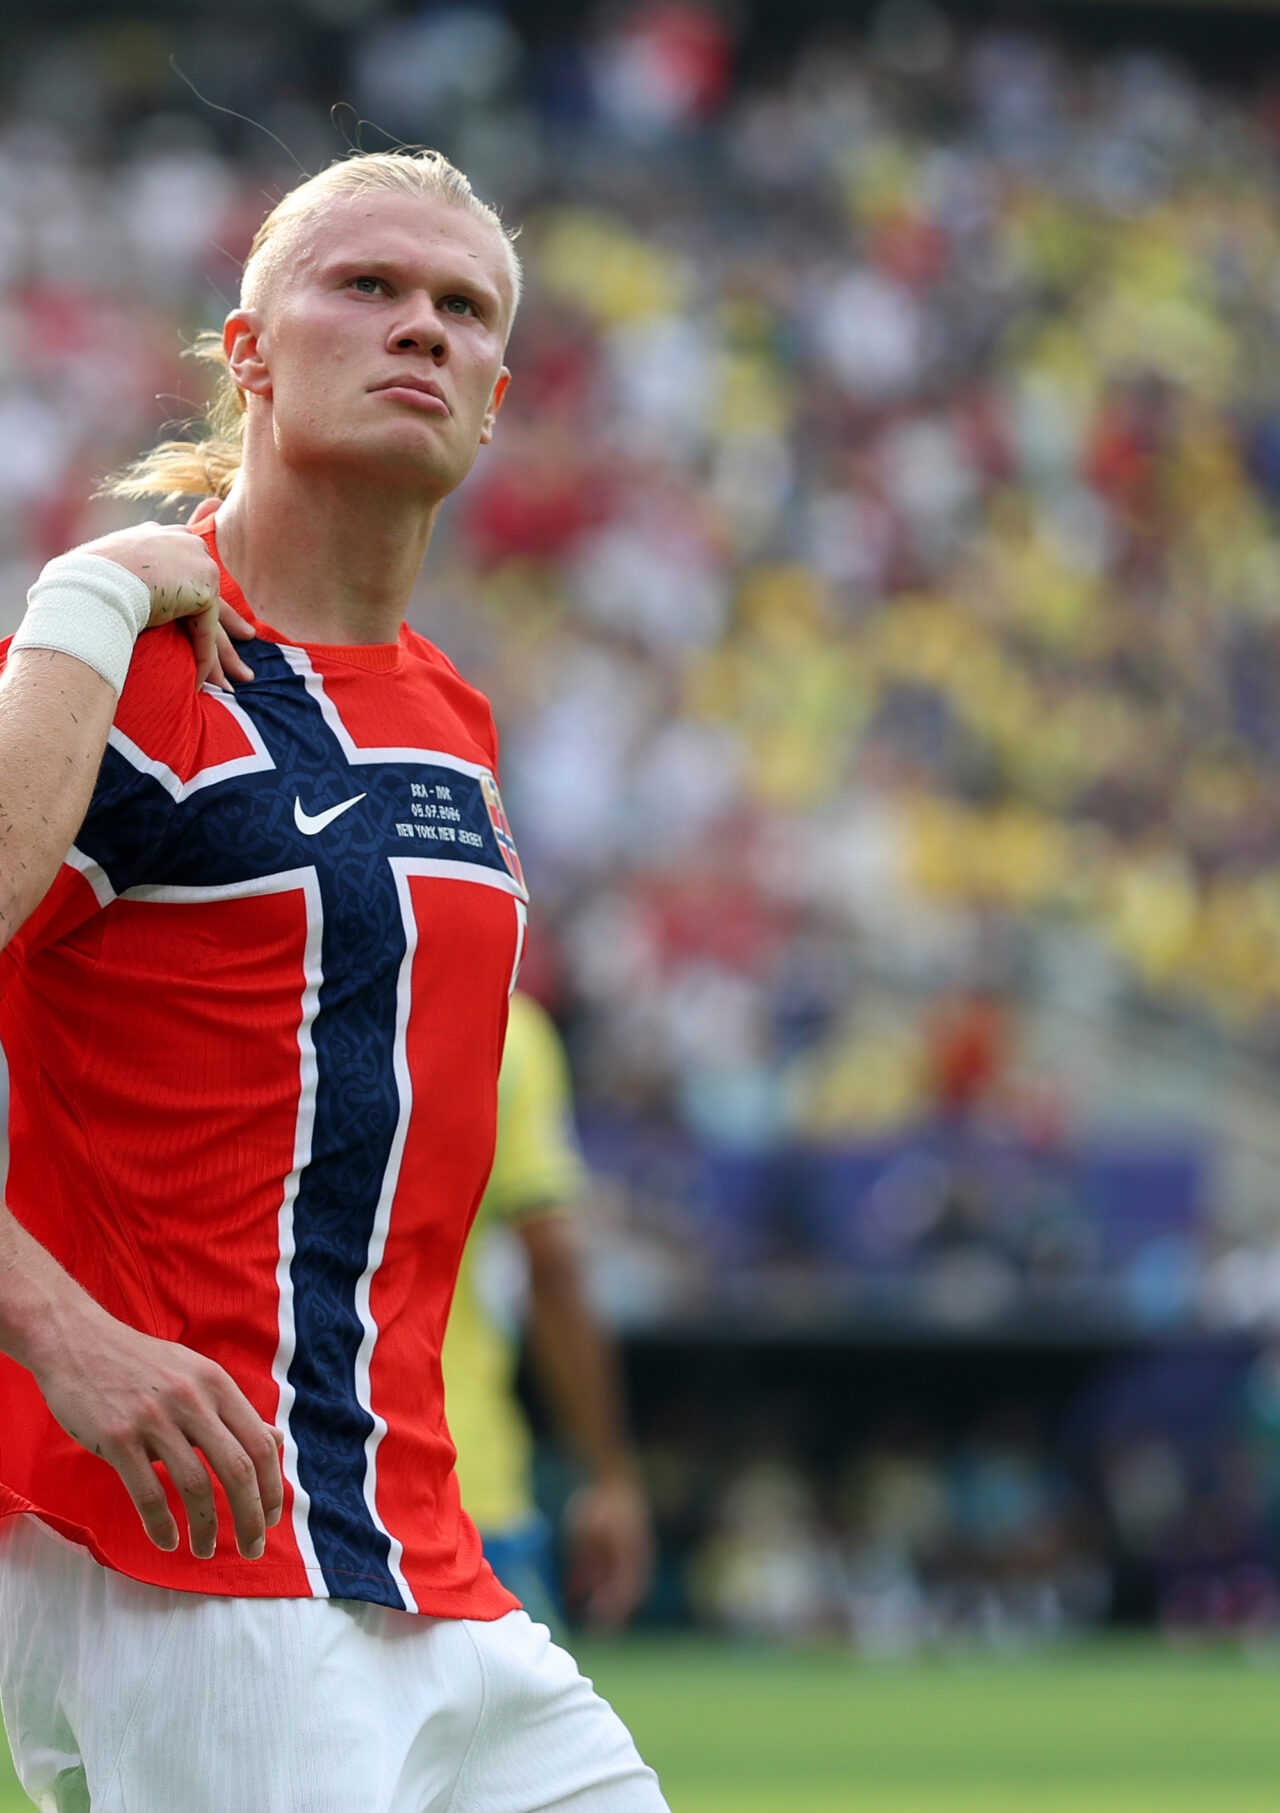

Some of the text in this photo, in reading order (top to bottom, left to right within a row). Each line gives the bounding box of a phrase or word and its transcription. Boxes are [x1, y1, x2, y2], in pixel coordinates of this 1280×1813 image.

[410, 783, 428, 798] BRA
[435, 785, 452, 800] NOR
[411, 803, 461, 822] 05.07.2026
[395, 823, 484, 848] NEW YORK NEW JERSEY
